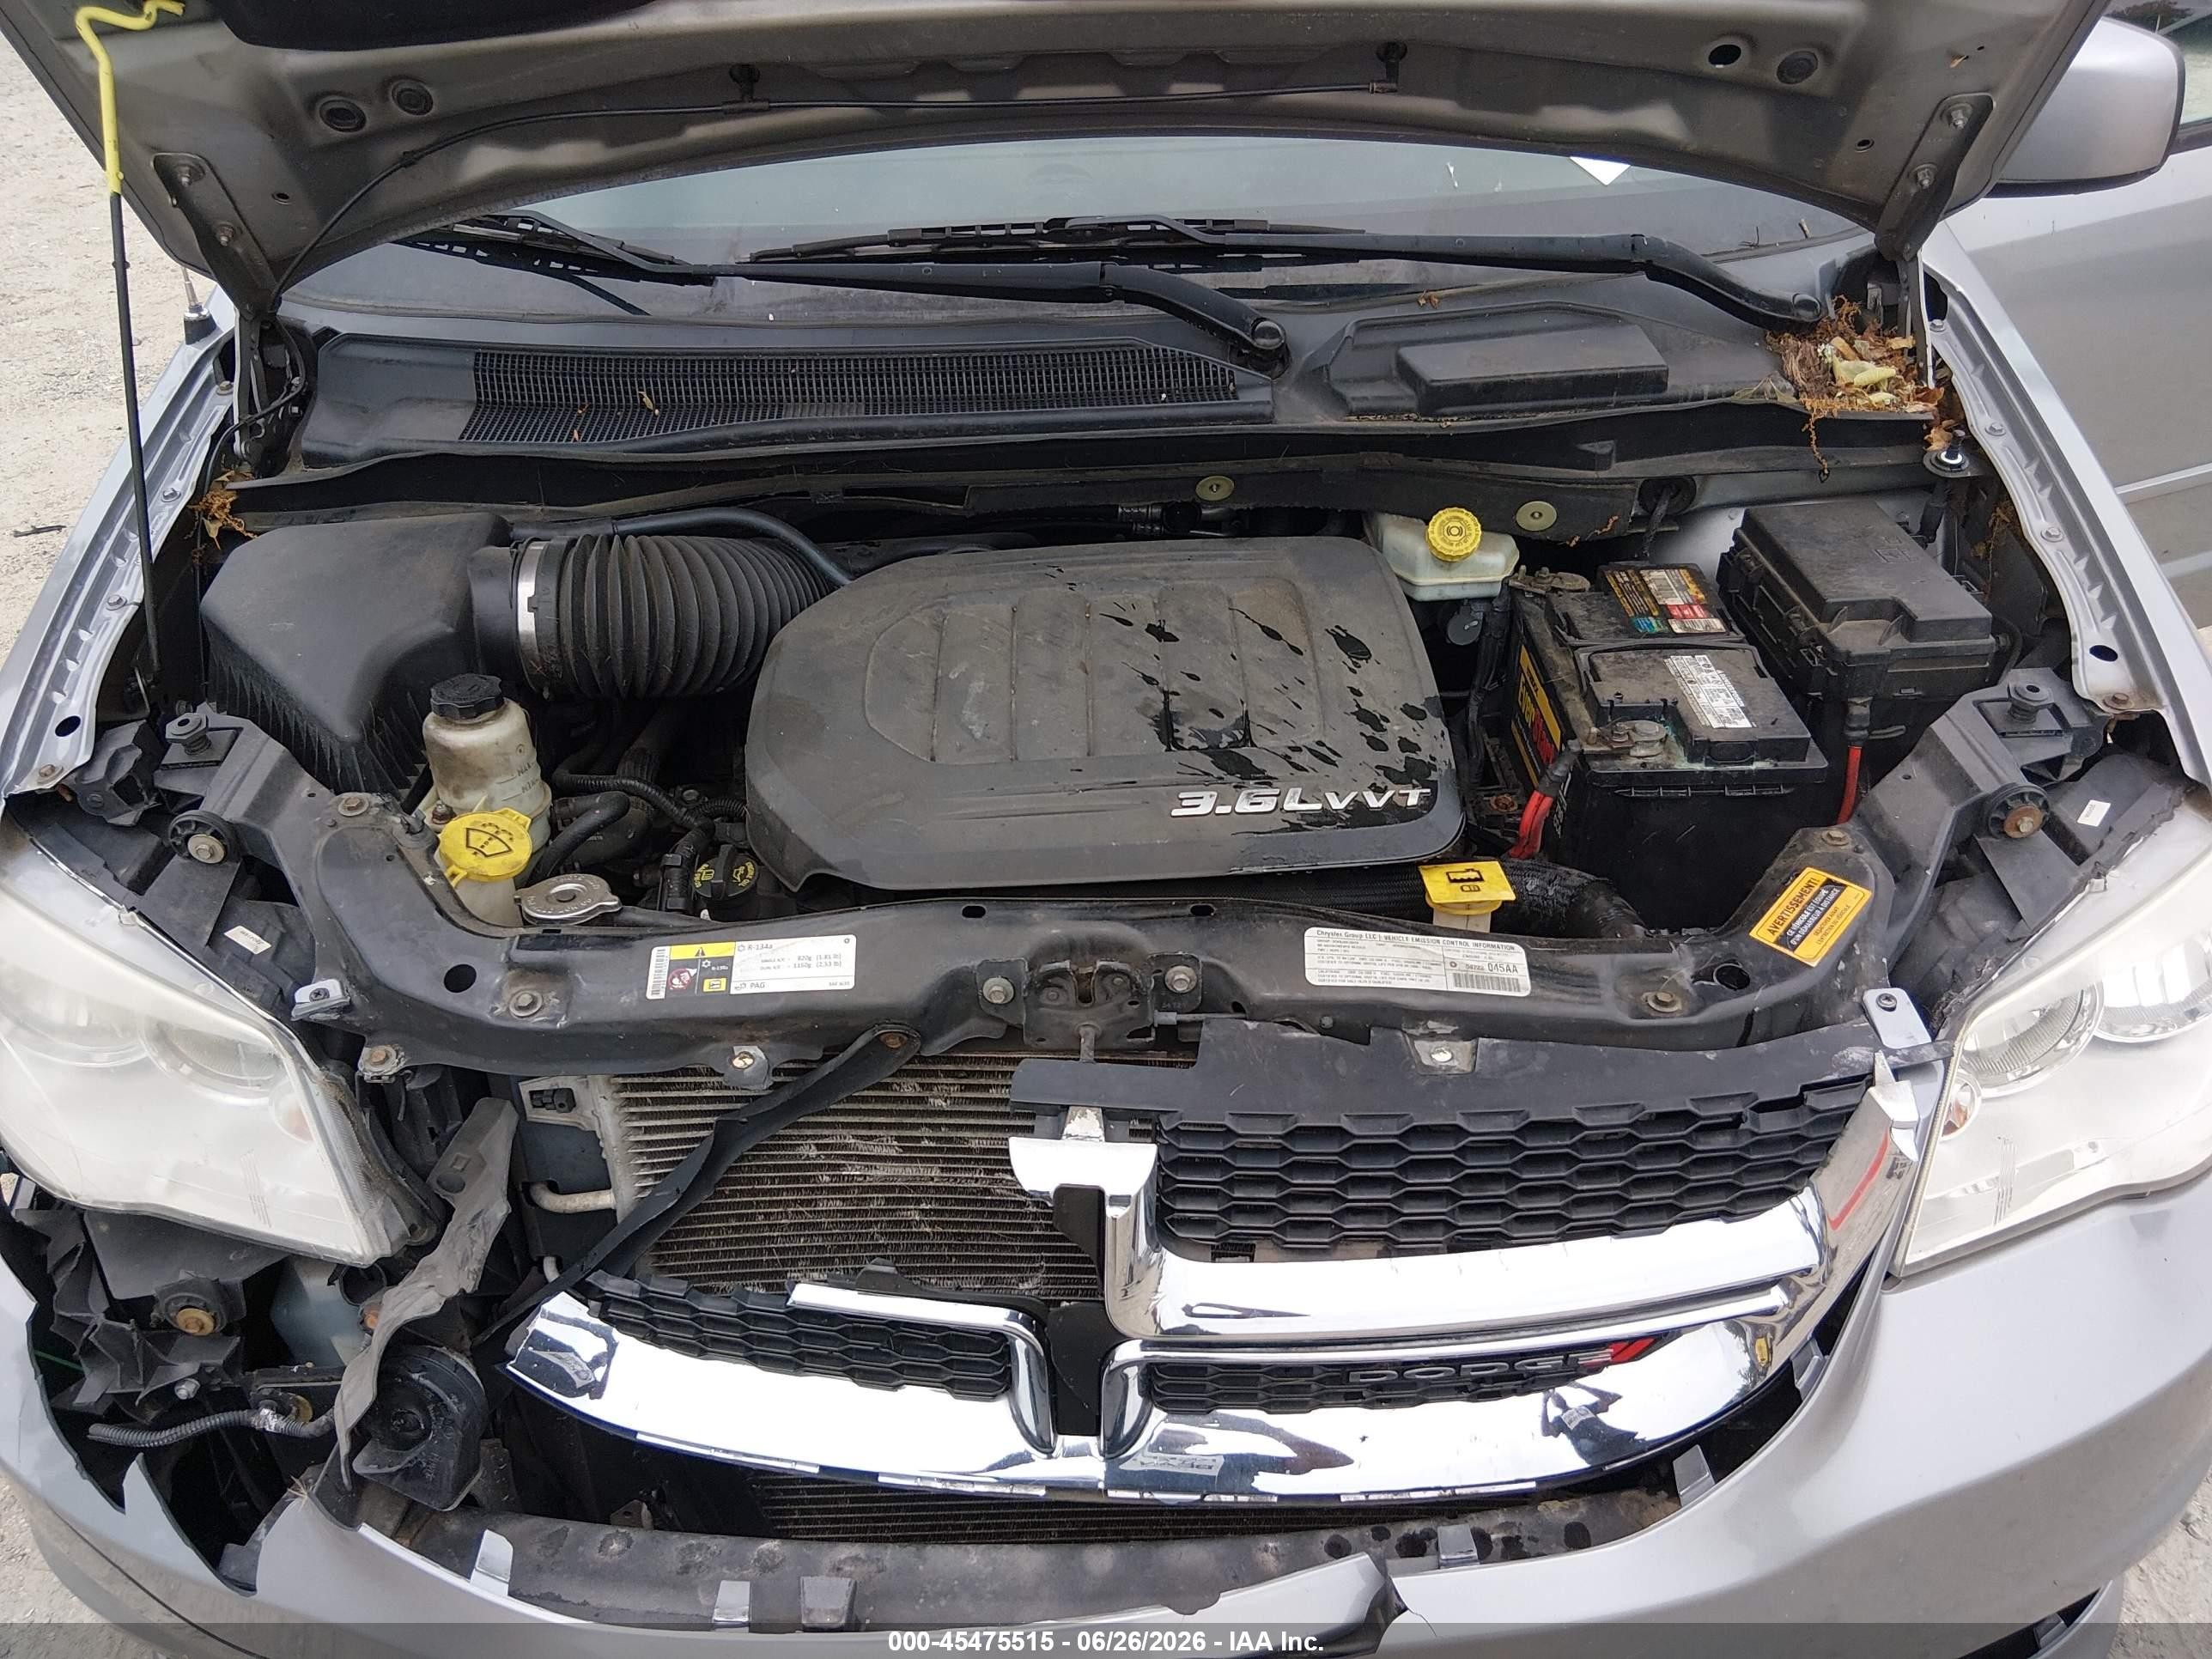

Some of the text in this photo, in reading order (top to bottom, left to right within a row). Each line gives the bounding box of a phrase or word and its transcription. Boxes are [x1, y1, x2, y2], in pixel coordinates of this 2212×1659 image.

[1767, 878, 1820, 937] AVERTISSEMENT!
[1316, 929, 1342, 939] Chrysler
[1344, 932, 1364, 941] Group
[1384, 934, 1409, 943] VEHICLE
[1411, 936, 1440, 945] EMISSION
[1443, 939, 1470, 948] CONTROL
[1473, 942, 1516, 951] INFORMATION
[1487, 962, 1519, 974] 045AA
[1348, 1348, 1614, 1382] DODGE
